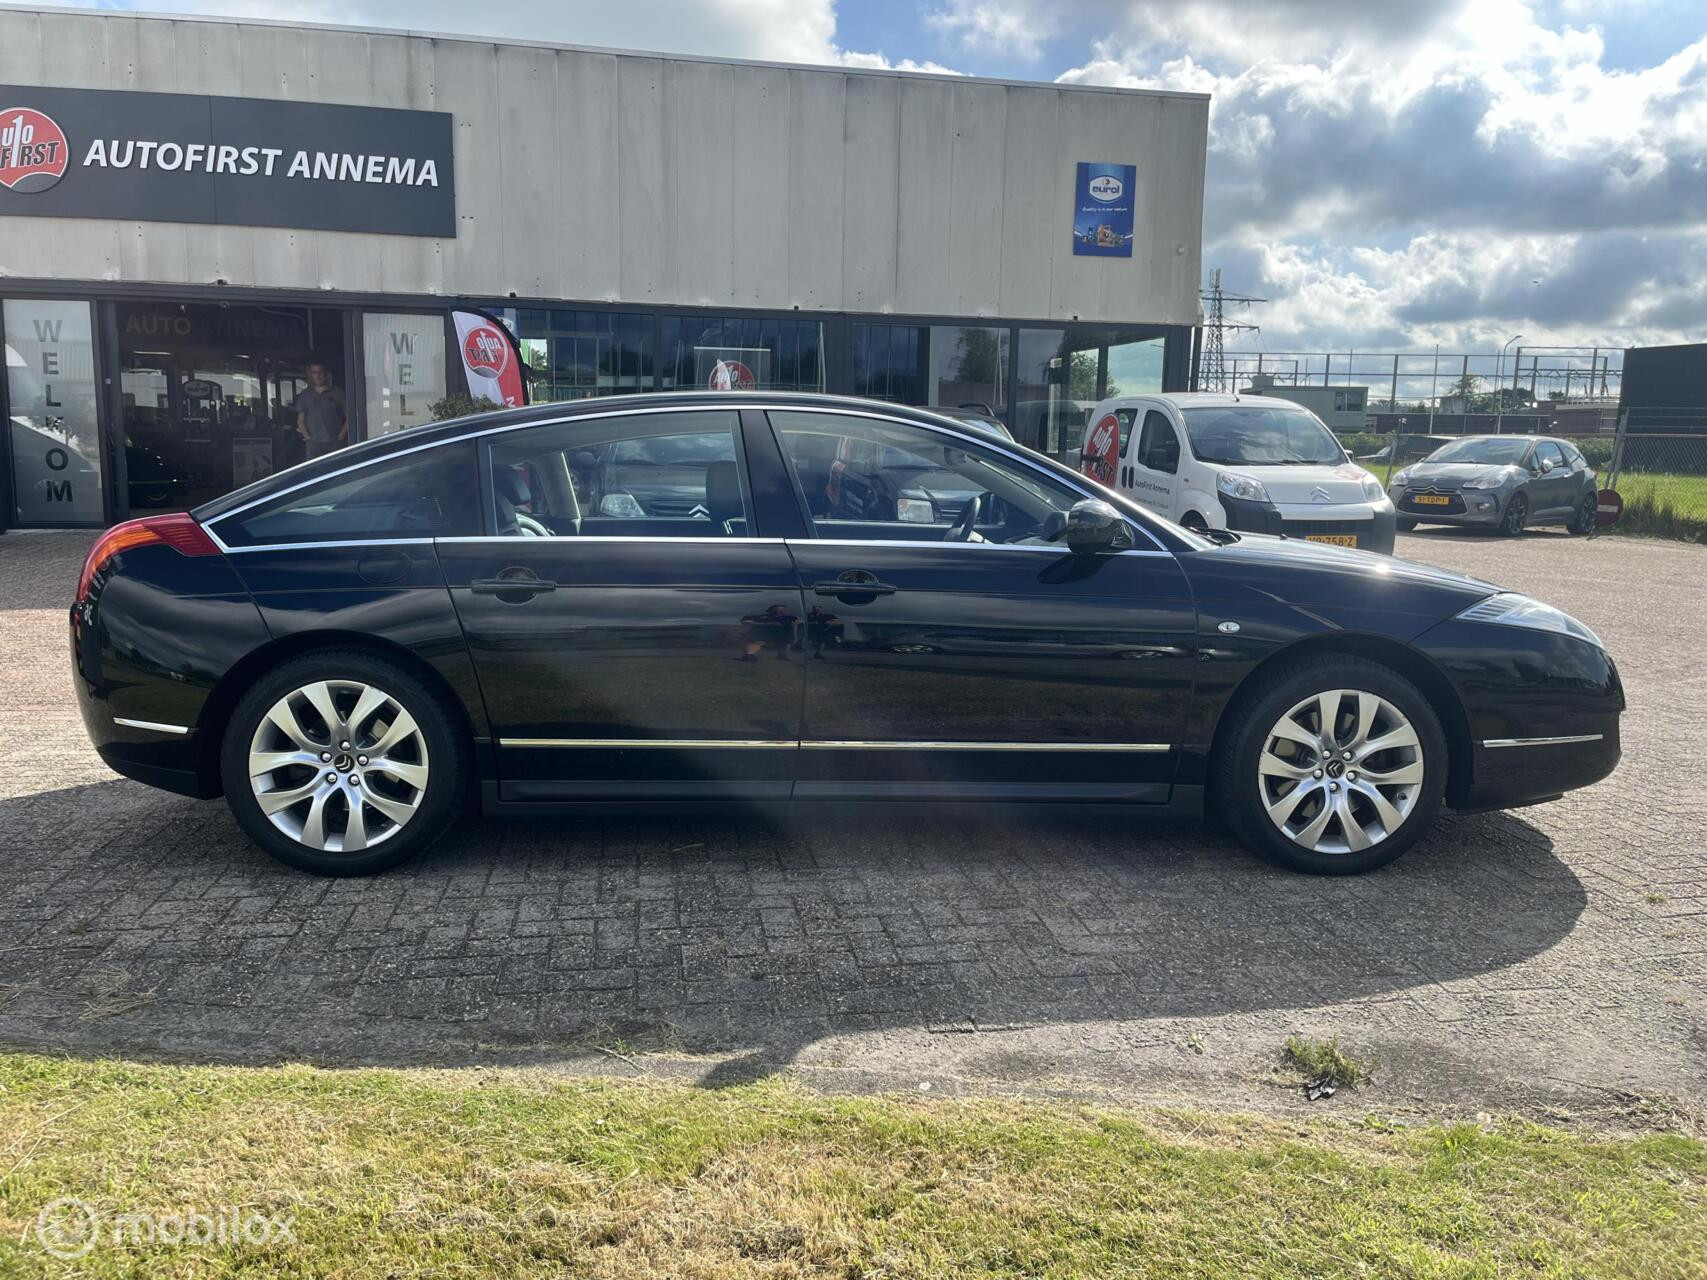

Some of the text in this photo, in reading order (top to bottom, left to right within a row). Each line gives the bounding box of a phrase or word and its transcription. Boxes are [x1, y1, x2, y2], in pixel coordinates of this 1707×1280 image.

[83, 139, 439, 187] AUTOFIRST ANNEMA
[1092, 185, 1121, 195] eurol
[125, 315, 193, 336] AUTO
